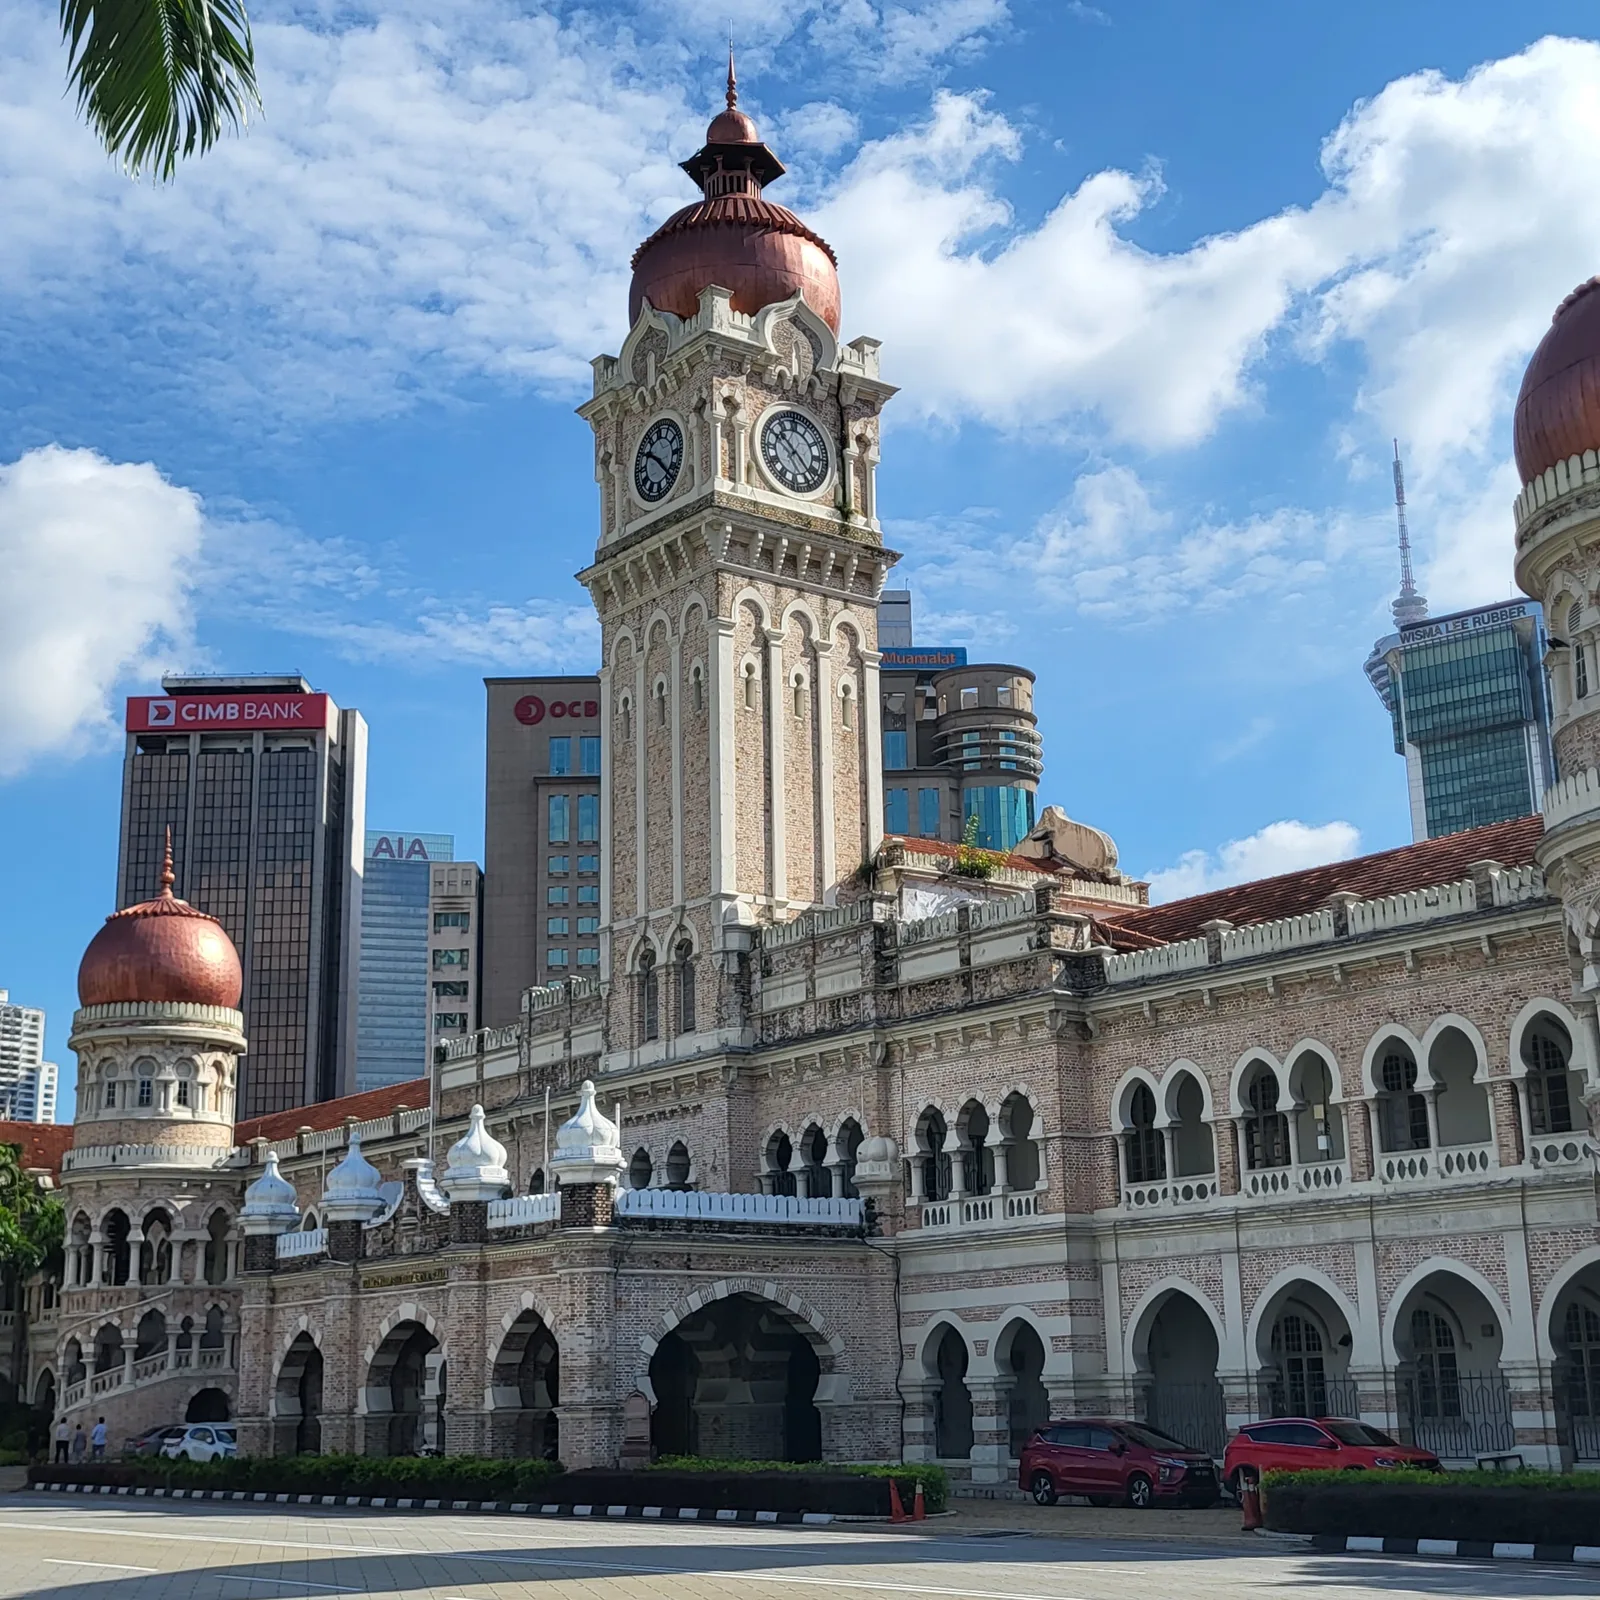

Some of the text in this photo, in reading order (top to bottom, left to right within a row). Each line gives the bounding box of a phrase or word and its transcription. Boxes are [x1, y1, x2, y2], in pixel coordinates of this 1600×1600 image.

[1400, 605, 1526, 644] WISMA LEE RUBBER
[882, 651, 956, 664] Muamalat
[181, 702, 303, 720] CIMB BANK
[372, 836, 429, 860] AIA
